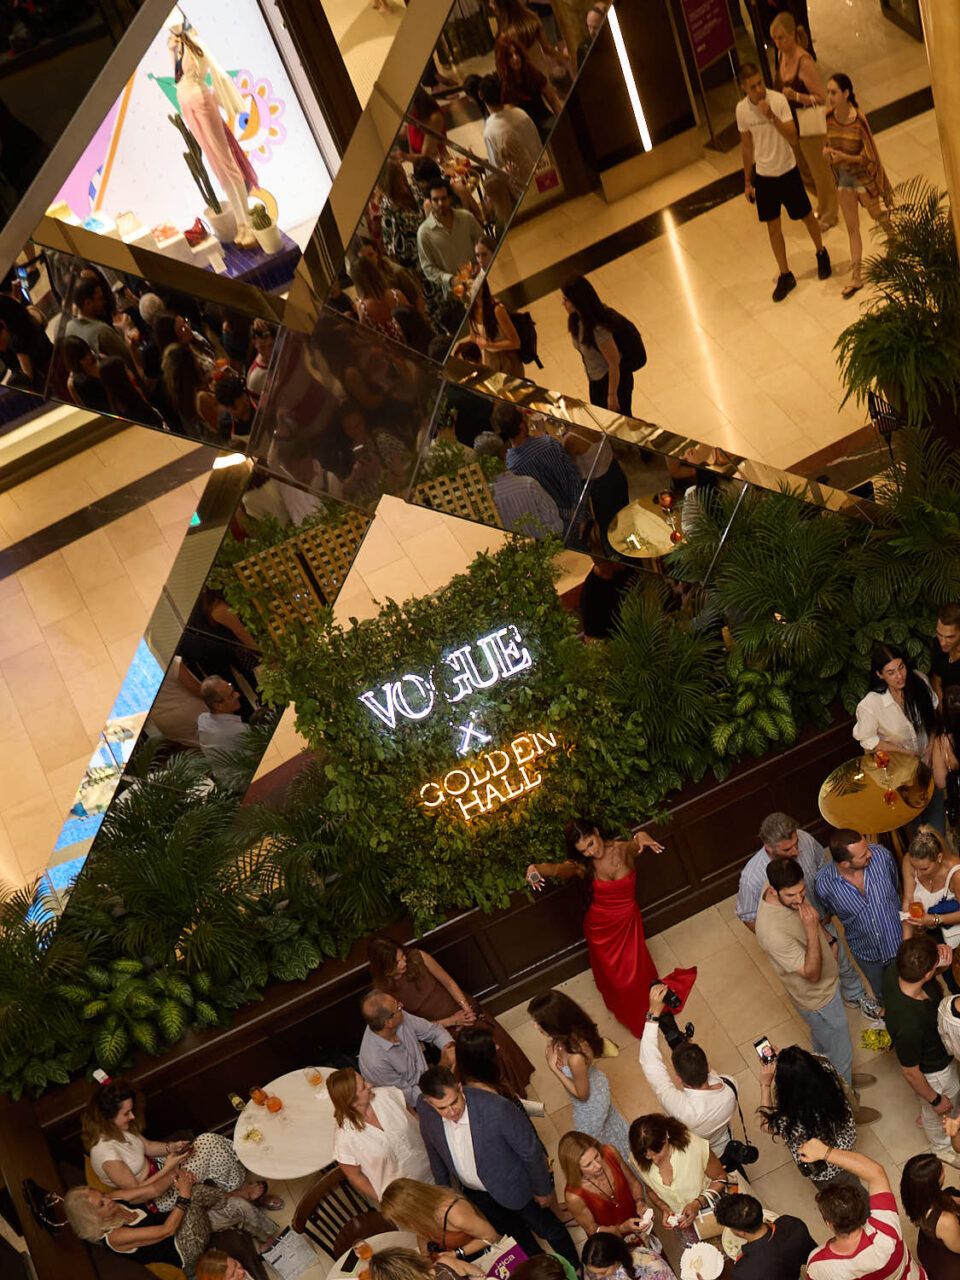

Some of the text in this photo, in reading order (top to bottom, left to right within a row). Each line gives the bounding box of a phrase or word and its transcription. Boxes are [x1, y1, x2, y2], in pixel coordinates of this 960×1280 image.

[357, 624, 533, 729] VOGUE
[420, 732, 557, 807] GOLDEN
[455, 766, 542, 820] HALL
